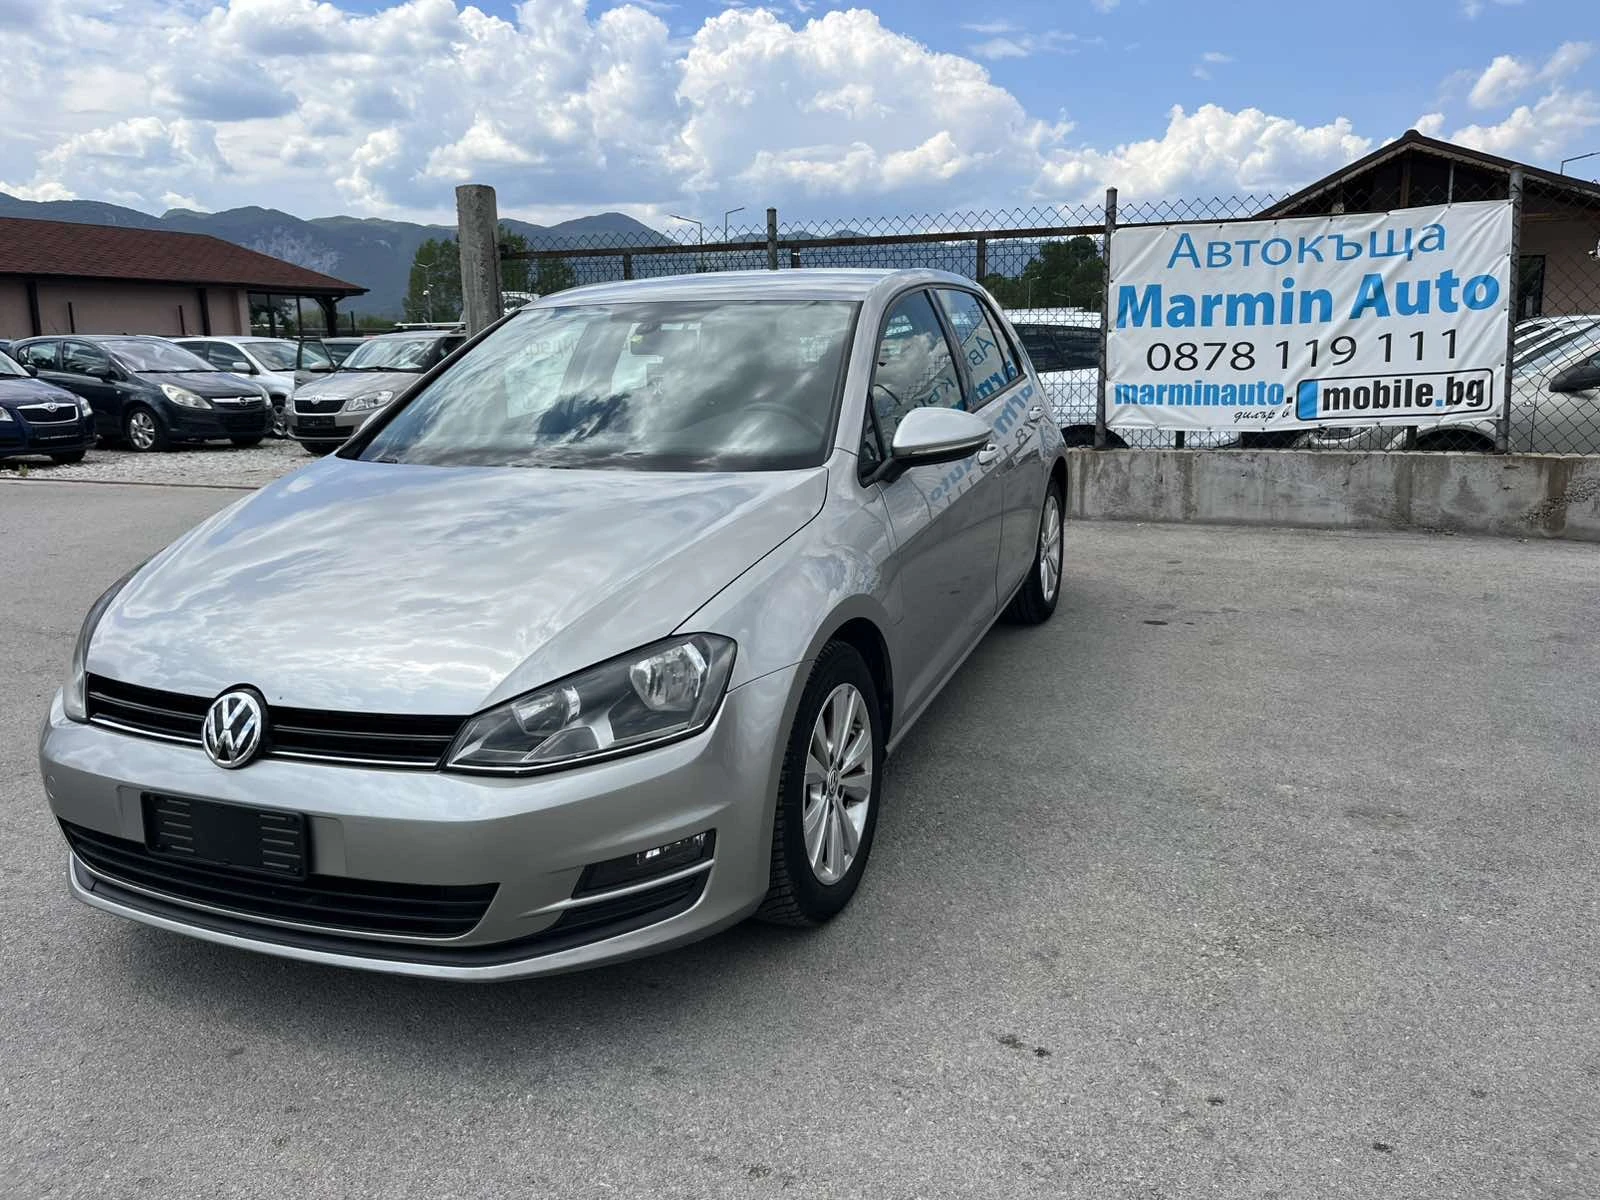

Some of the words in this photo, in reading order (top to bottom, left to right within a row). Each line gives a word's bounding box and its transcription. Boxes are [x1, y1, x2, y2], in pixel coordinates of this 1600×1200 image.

[1167, 223, 1446, 268] Автокъща
[1116, 277, 1333, 328] Marmin
[1348, 269, 1500, 320] Auto
[1146, 341, 1256, 371] 0878
[1275, 336, 1357, 369] 119
[1378, 328, 1457, 363] 111
[1322, 376, 1485, 411] mobile.bg
